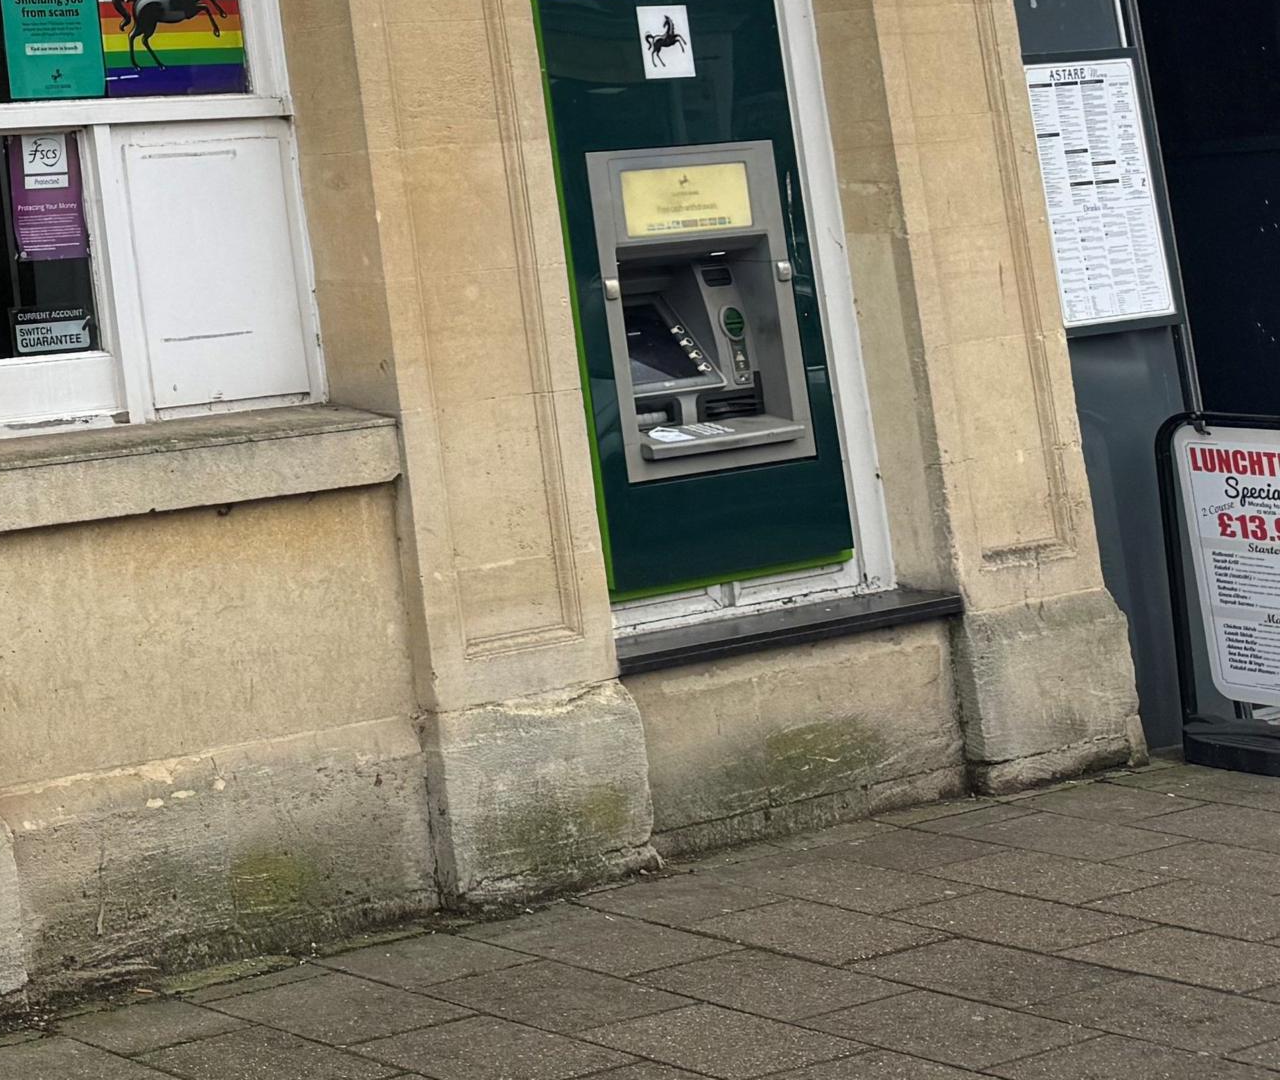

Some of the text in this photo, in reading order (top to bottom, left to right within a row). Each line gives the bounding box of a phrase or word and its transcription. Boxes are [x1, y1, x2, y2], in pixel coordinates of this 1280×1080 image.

[21, 7, 80, 18] from scams
[1049, 67, 1086, 81] ASTARE
[17, 204, 45, 212] Protecting
[17, 308, 83, 321] CURRENT ACCOUNT
[19, 326, 52, 337] SWITCH
[20, 333, 82, 349] GUARANTEE
[1201, 501, 1235, 517] 2 Course
[1247, 500, 1272, 510] Monday
[1225, 636, 1245, 644] Chicken
[1248, 659, 1265, 667] Wings
